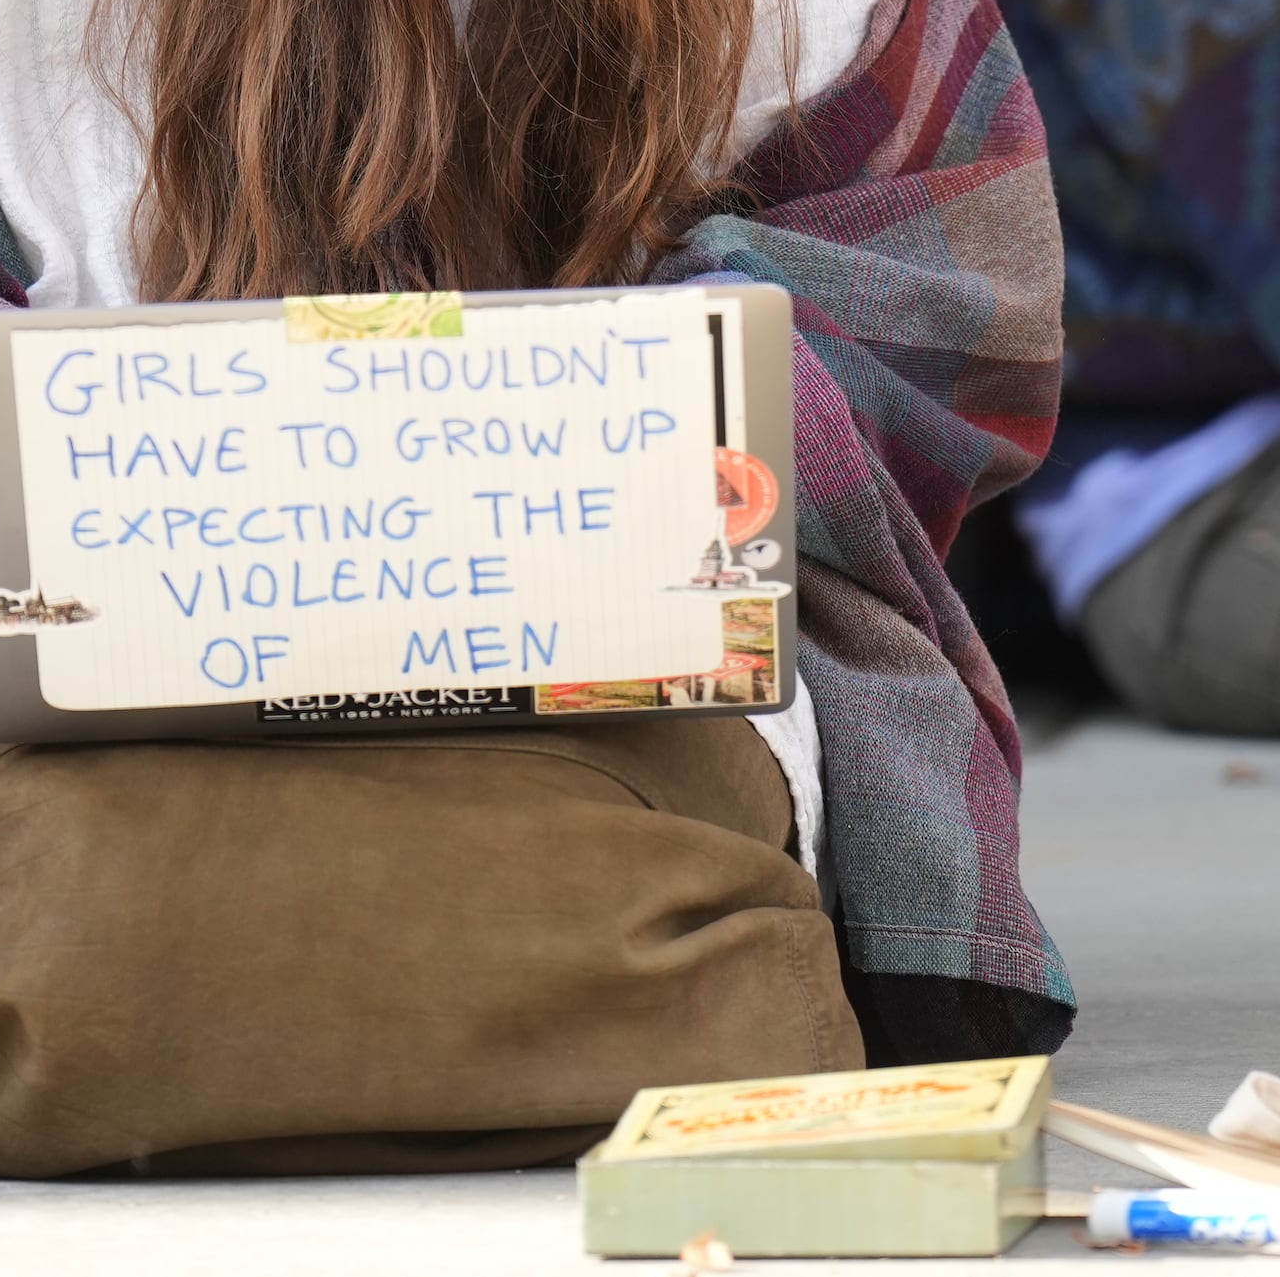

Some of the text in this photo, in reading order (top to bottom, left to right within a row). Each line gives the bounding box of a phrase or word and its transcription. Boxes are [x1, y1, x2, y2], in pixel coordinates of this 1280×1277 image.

[45, 328, 670, 416] GIRLS SHOULDN'T
[66, 409, 677, 480] HAVE TO GROW UP
[72, 487, 615, 550] EXPECTING THE
[160, 555, 515, 618] VIOLENCE
[200, 621, 559, 689] OF MEN
[262, 685, 513, 712] RED JACKET
[399, 707, 435, 718] NEW
[440, 705, 483, 717] YORK
